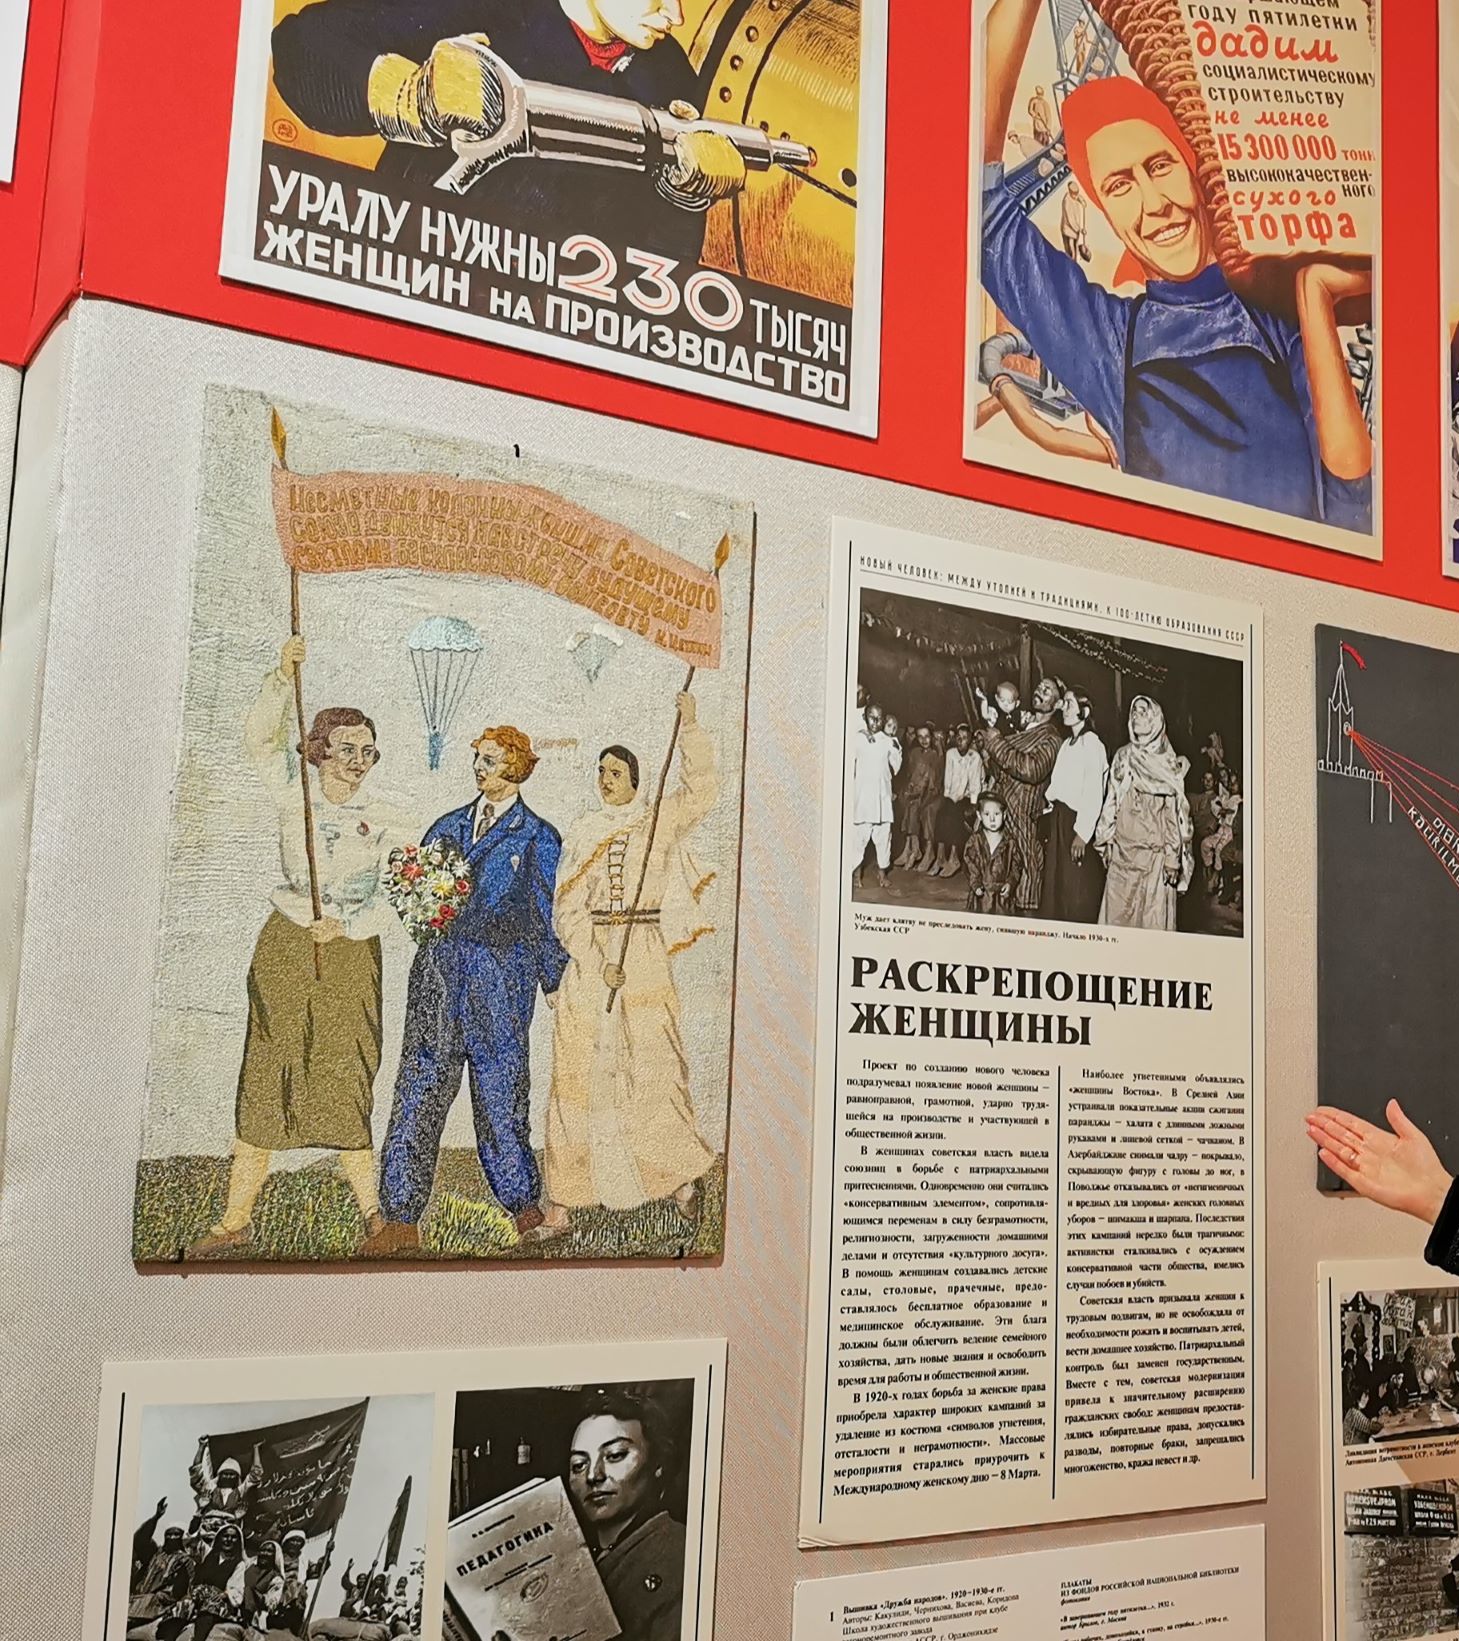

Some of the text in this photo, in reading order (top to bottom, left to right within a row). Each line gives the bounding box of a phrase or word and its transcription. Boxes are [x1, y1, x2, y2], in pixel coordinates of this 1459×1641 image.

[1187, 4, 1237, 24] году
[1249, 9, 1358, 32] пятилетки
[1192, 20, 1338, 64] дадим
[1208, 86, 1344, 109] строительству
[1215, 110, 1329, 128] не менее
[1244, 133, 1289, 161] 300
[1292, 133, 1336, 161] 000
[1232, 189, 1336, 213] сухого
[1236, 210, 1357, 247] торфа
[266, 165, 847, 366] УРАЛУ НУЖНЫ 230 ТЫСЯЧ
[261, 220, 847, 406] ЖЕНЩИН НА ПРОИЗВОДСТВО
[859, 554, 1244, 642] НОВЫЙ ЧЕЛОВЕК: МЕЖДУ УТОПИЕЙ И ТРАДИЦИЯМИ. К 100-ЛЕТИЮ ОБРАЗОВАНИЯ СССР
[854, 912, 872, 924] Муж
[927, 920, 973, 931] преследовать
[854, 921, 910, 934] Узбекская ССР
[851, 956, 1213, 1011] РАСКРЕПОЩЕНИЕ
[848, 1002, 1091, 1048] ЖЕНЩИНЫ
[862, 1058, 1049, 1076] Проект по созданию нового человека
[914, 1131, 946, 1139] жизни.
[860, 1145, 867, 1155] В
[875, 1148, 924, 1156] женщинах
[931, 1149, 976, 1157] советская
[1019, 1150, 1048, 1158] видела
[841, 1252, 876, 1261] делами
[1011, 1249, 1047, 1259] досуга».
[1041, 1299, 1047, 1307] и
[994, 1314, 1012, 1325] Эти
[1022, 1313, 1046, 1324] блага
[853, 1383, 1045, 1403] В 1920-х годах борьба за женские права
[912, 1458, 964, 1472] старались
[1039, 1451, 1045, 1459] к
[456, 1522, 554, 1577] ПЕДАГОГИКА
[1061, 1578, 1092, 1589] ПЛАКАТЫ
[1101, 1578, 1145, 1592] РОССИЙСКОЙ
[841, 1614, 873, 1625] Авторы:
[842, 1625, 868, 1636] Школа
[869, 1616, 931, 1633] художественного
[973, 1608, 988, 1617] при
[988, 1603, 1008, 1615] клубе
